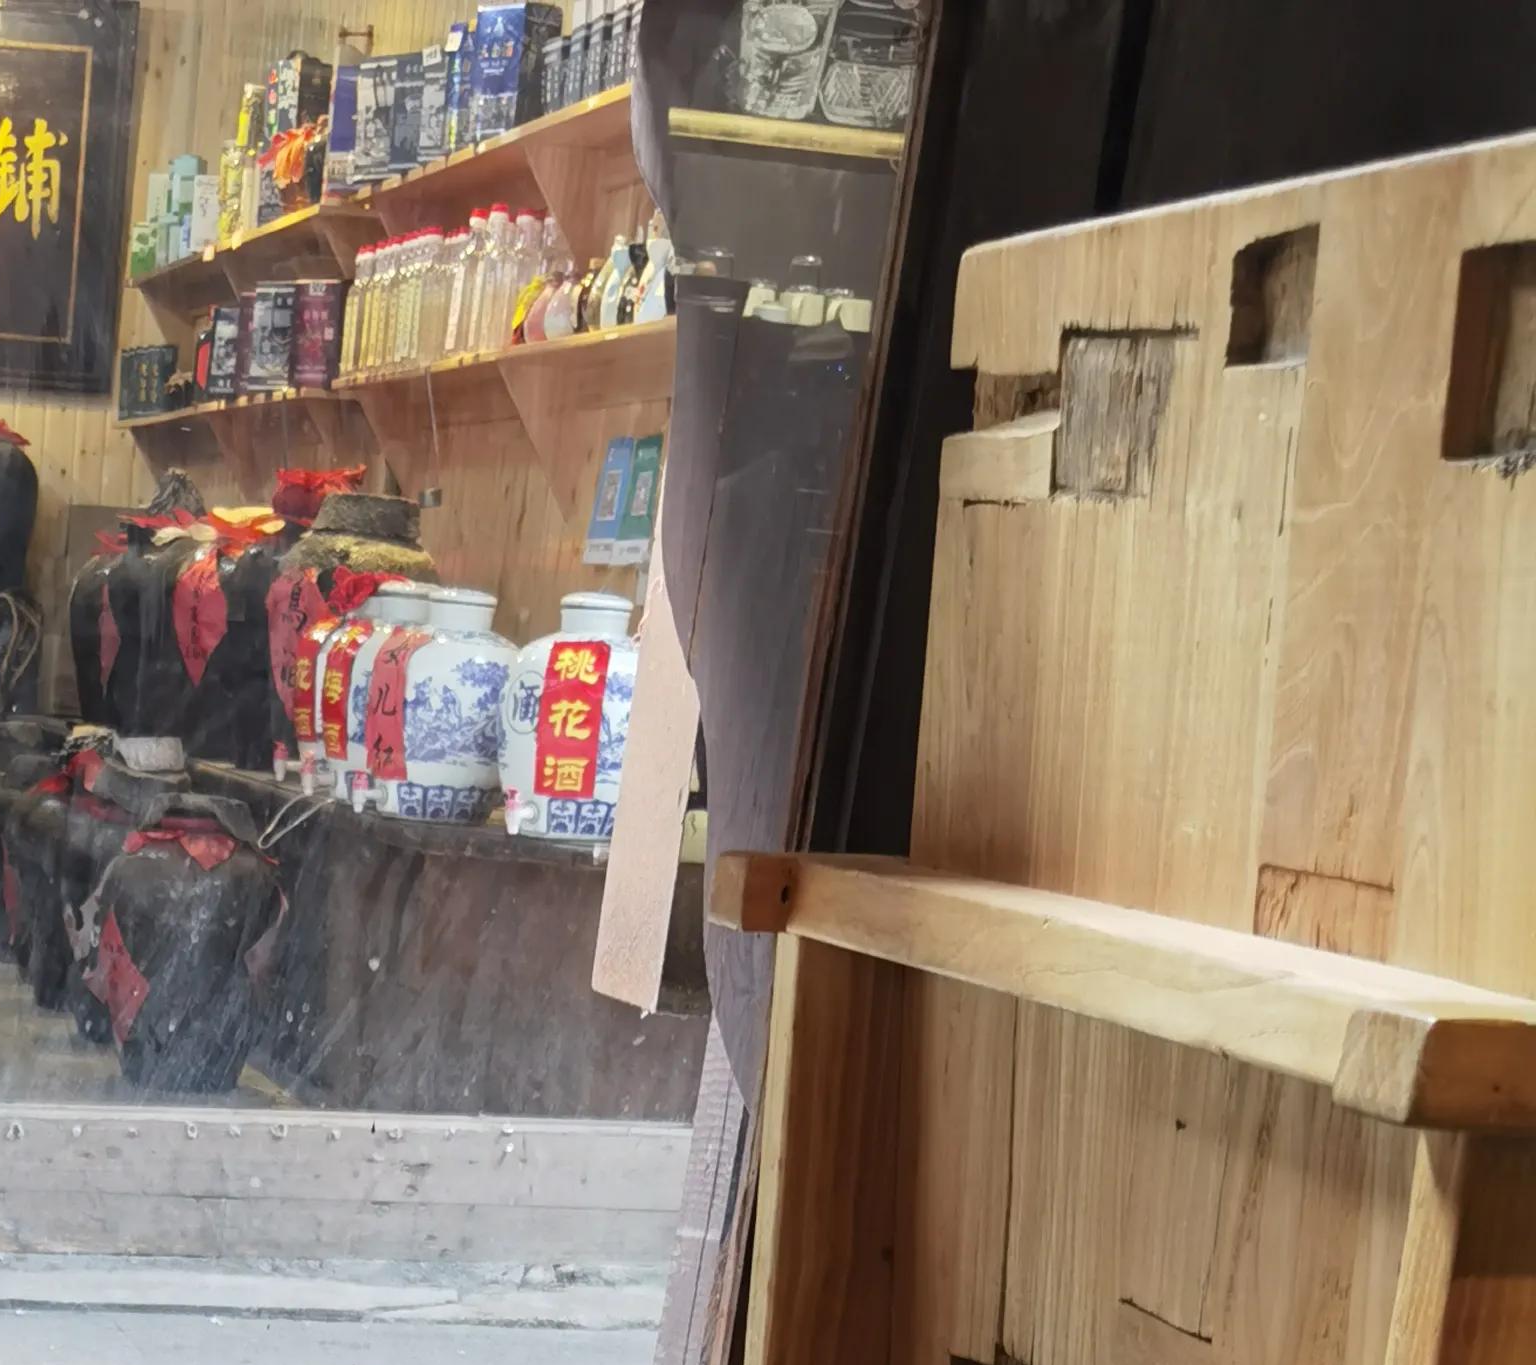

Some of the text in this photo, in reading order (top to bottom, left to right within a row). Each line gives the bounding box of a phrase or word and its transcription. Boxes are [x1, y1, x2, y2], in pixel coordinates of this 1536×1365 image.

[371, 637, 410, 769] 女儿红
[543, 647, 601, 792] 桃花酒
